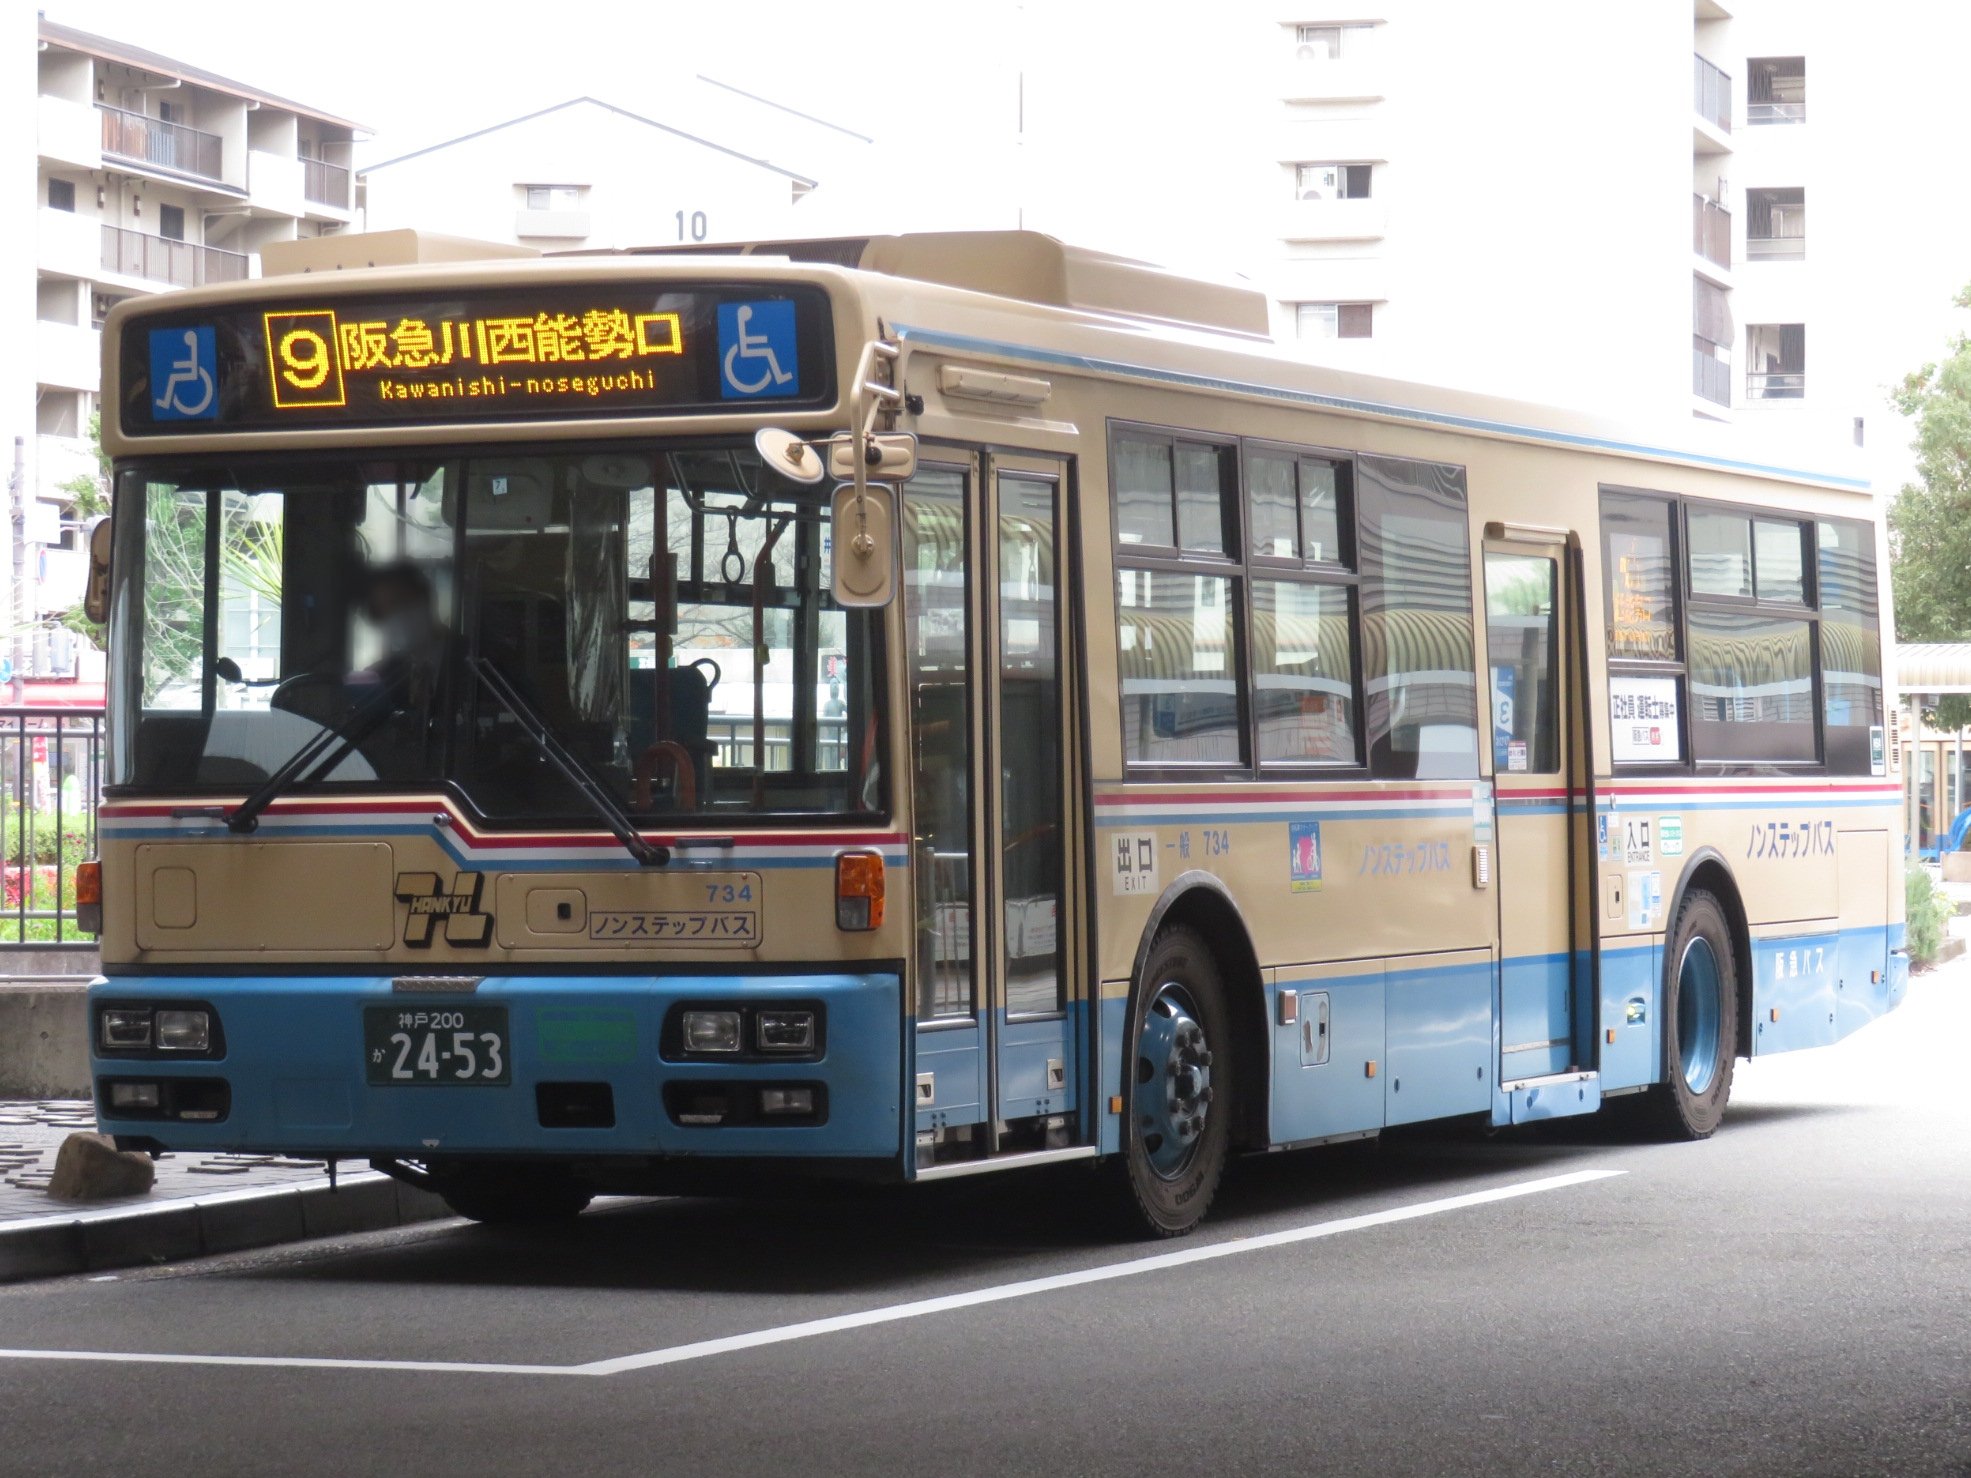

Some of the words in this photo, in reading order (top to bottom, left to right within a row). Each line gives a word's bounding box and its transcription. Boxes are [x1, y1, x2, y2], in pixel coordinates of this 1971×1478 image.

[675, 209, 707, 242] 10
[341, 310, 683, 369] 阪急川西能勢口
[278, 329, 329, 388] 9
[380, 370, 655, 401] Kawanishi-noseguchi
[1203, 830, 1230, 857] 734
[1627, 821, 1650, 850] 入口
[1746, 820, 1835, 860] ノンステップバス
[1117, 836, 1153, 875] 出口
[1359, 841, 1451, 876] ノンステップバス
[705, 884, 753, 902] 734
[1124, 875, 1148, 892] EXIT
[411, 894, 474, 914] HANKYU
[594, 913, 752, 936] ノンステップバス
[1775, 947, 1825, 981] 阪急バス
[390, 1032, 503, 1079] 24-53
